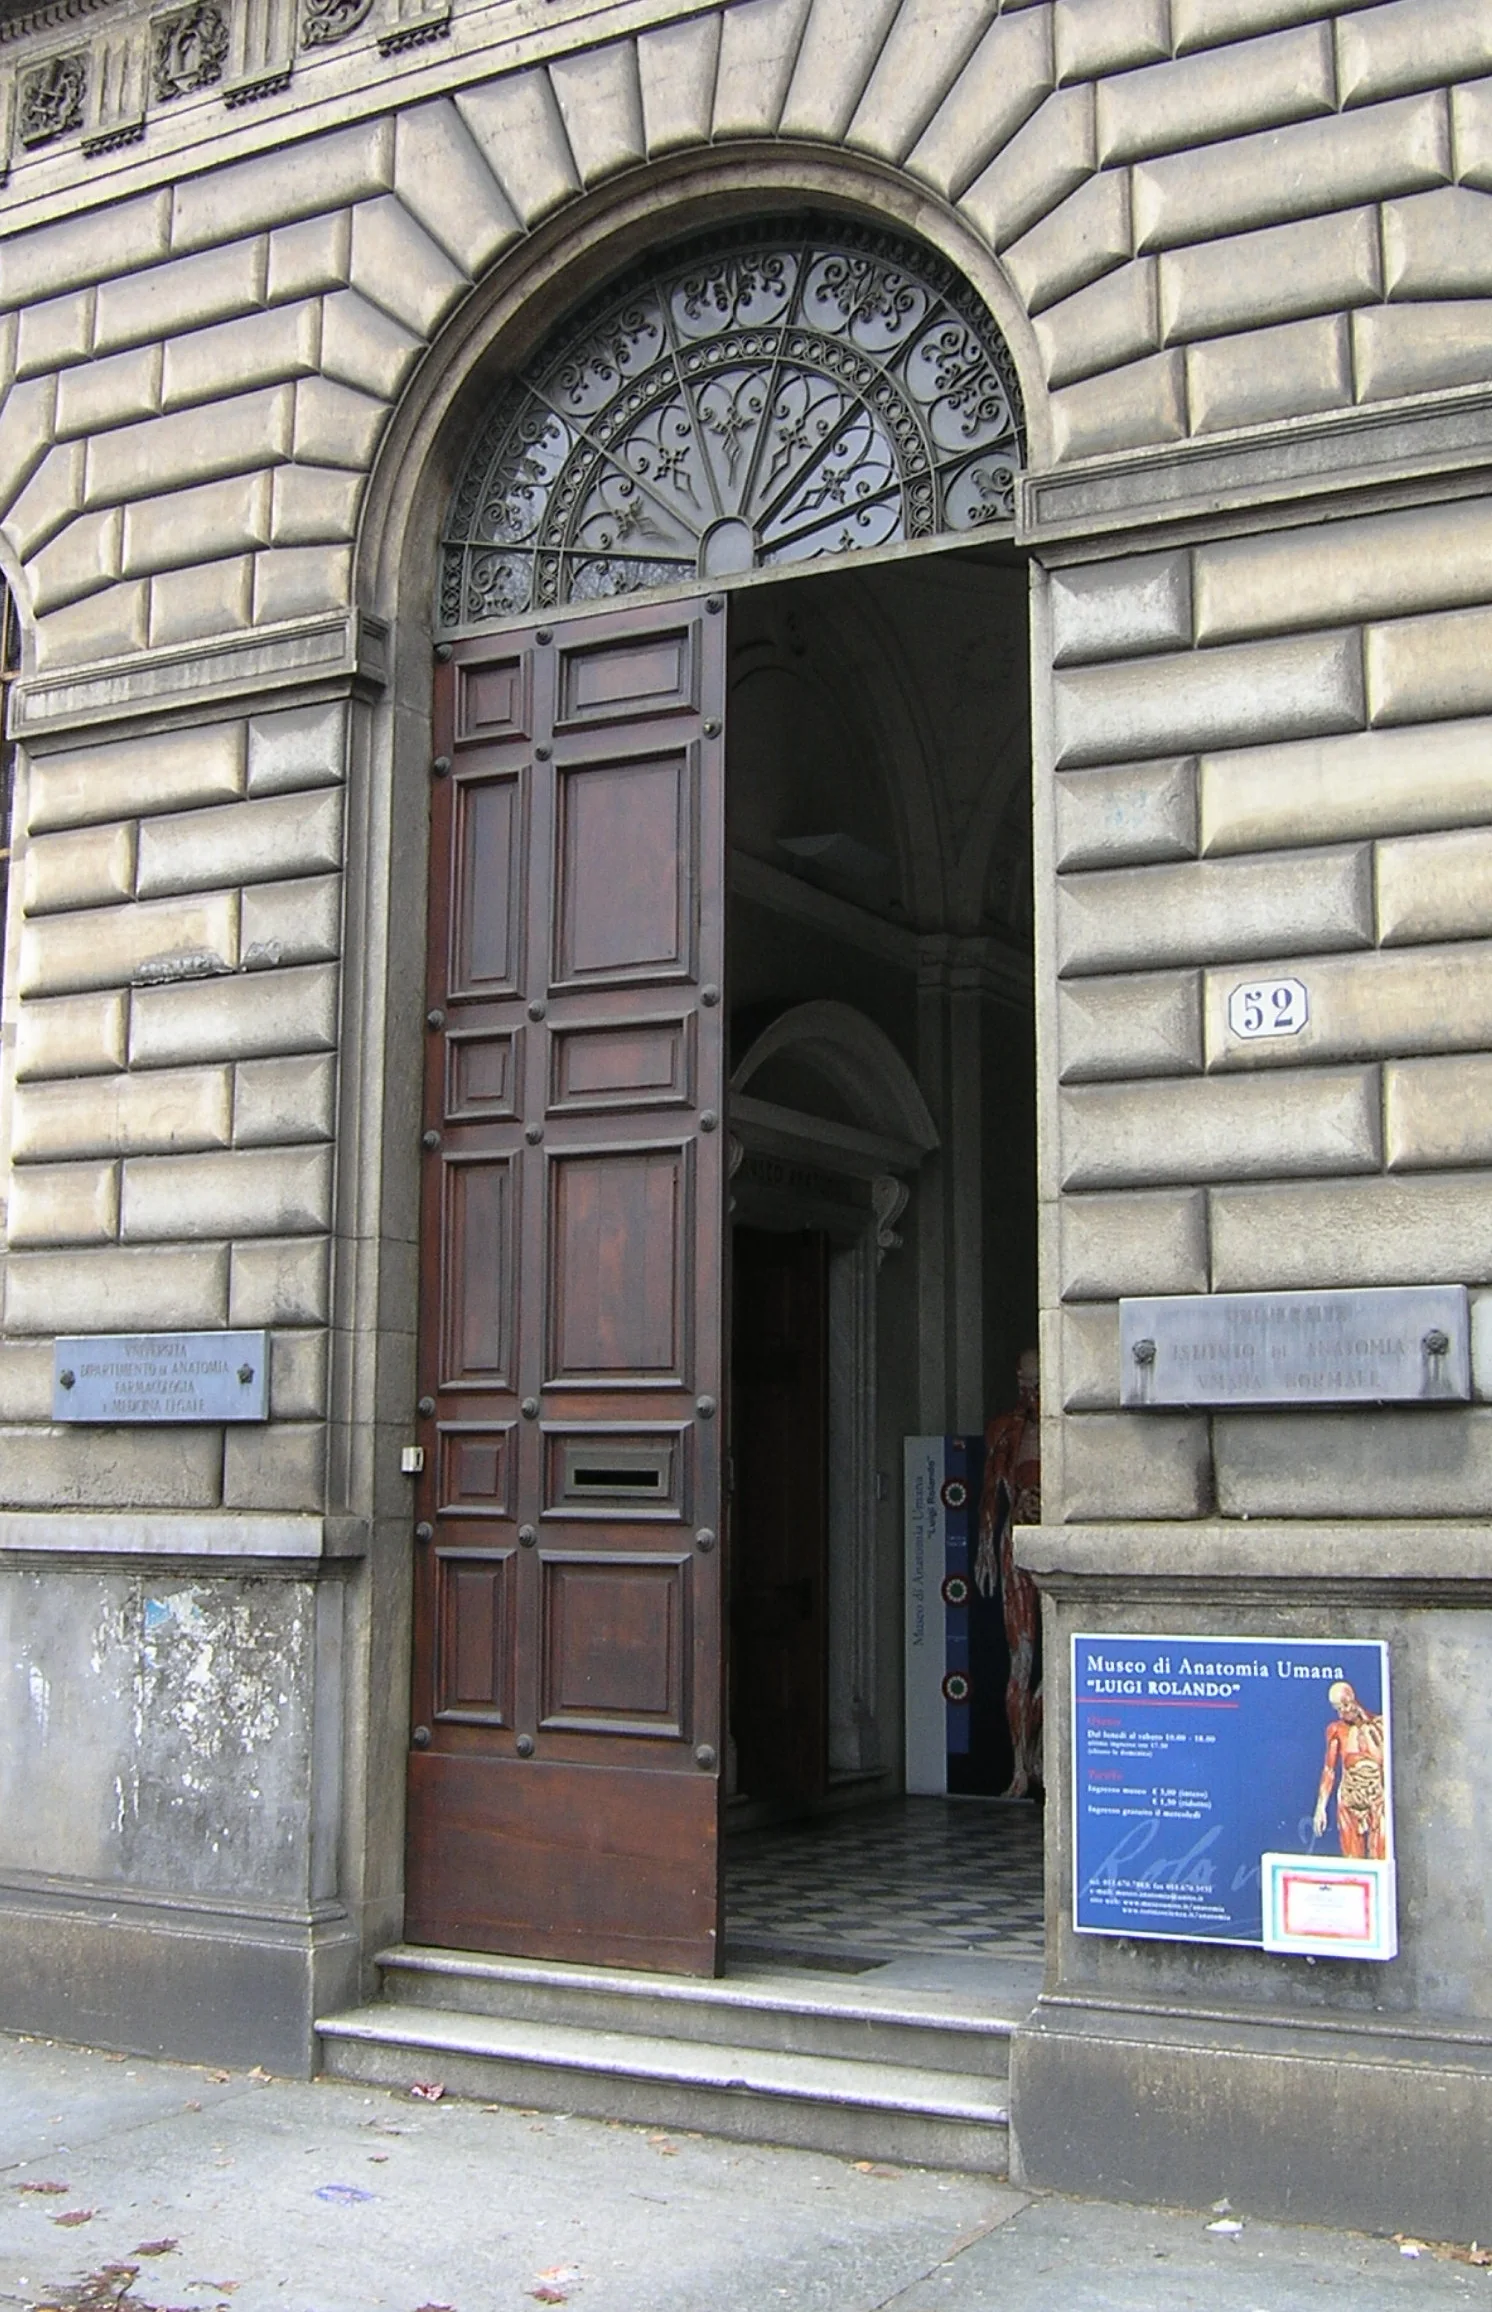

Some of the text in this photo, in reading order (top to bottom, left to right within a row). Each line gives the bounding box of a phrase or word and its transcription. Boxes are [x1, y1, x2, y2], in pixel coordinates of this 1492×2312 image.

[1244, 987, 1294, 1031] 52
[1306, 1337, 1406, 1358] ANATOMIA
[80, 1363, 156, 1377] DIPARTIMENTO
[172, 1360, 229, 1375] ANATOMIA
[115, 1380, 195, 1395] FARMACOLOGIA
[1284, 1370, 1381, 1389] NORMALE
[112, 1399, 162, 1413] MEDICINA
[165, 1398, 205, 1413] LEGALE
[912, 1476, 925, 1647] Museo di Anatomia Umana
[1087, 1655, 1344, 1679] Museo di Anatomia Umana
[1087, 1679, 1240, 1697] "LUIGI ROLANDO"
